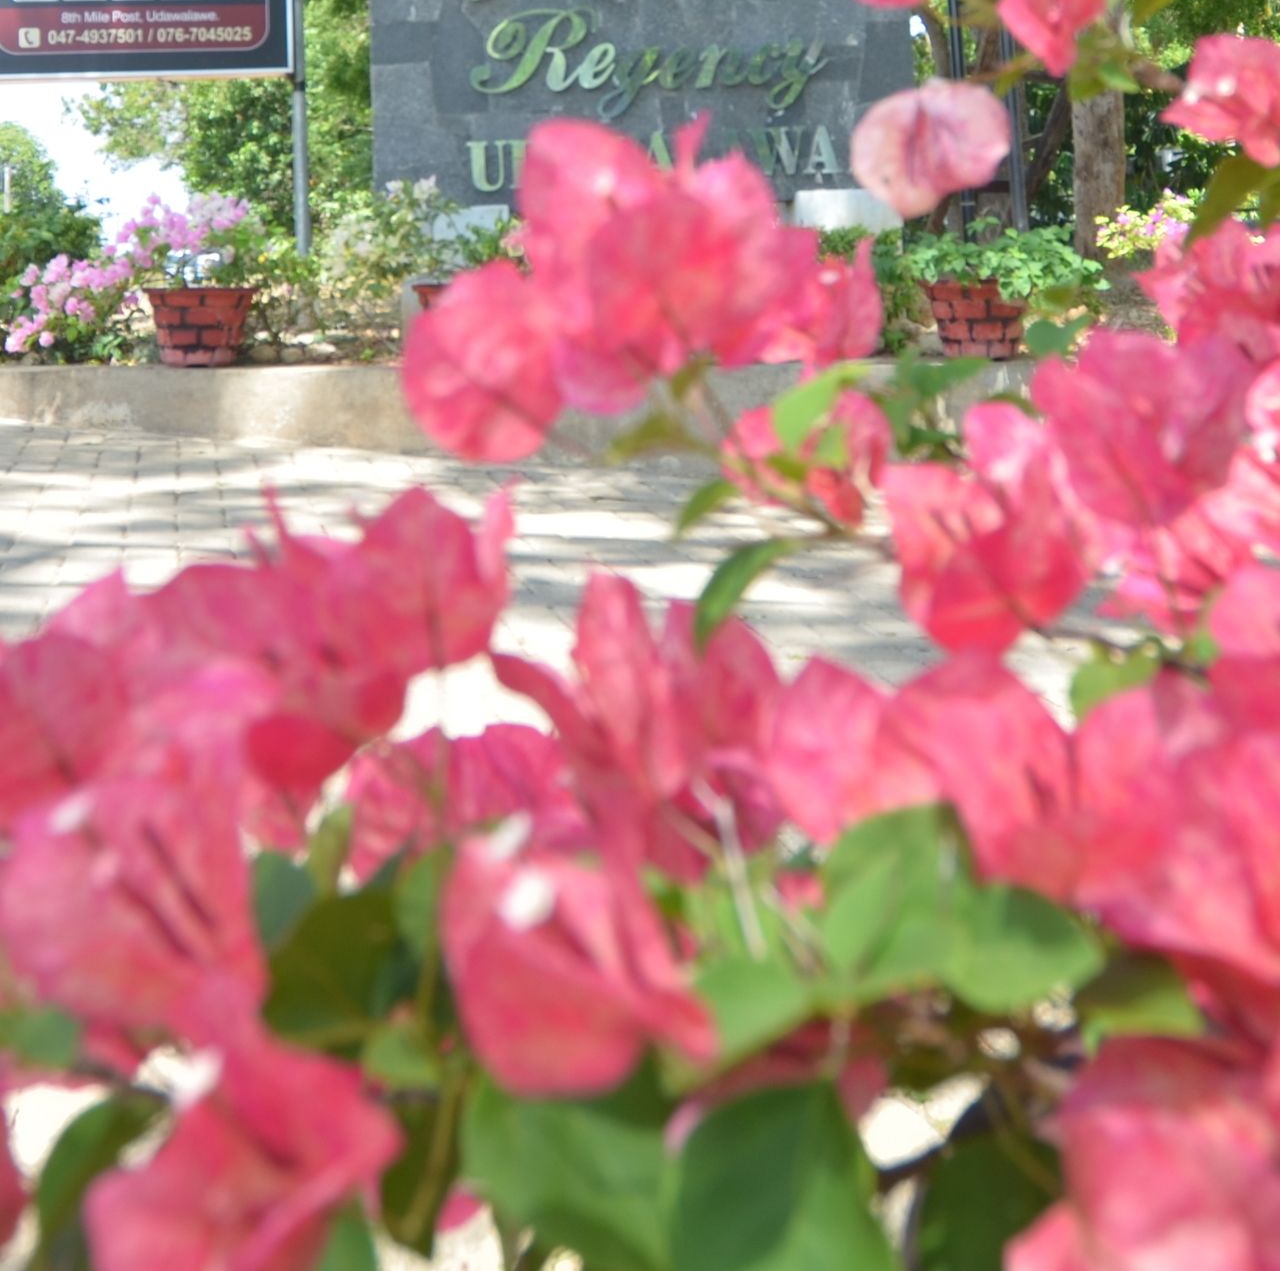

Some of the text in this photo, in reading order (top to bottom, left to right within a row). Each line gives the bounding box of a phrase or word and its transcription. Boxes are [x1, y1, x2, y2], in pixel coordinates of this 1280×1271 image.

[61, 11, 81, 23] 8th
[84, 11, 110, 23] Mile
[47, 28, 143, 44] 047-4937501
[156, 26, 253, 43] 076-7045025
[469, 7, 827, 119] Regency
